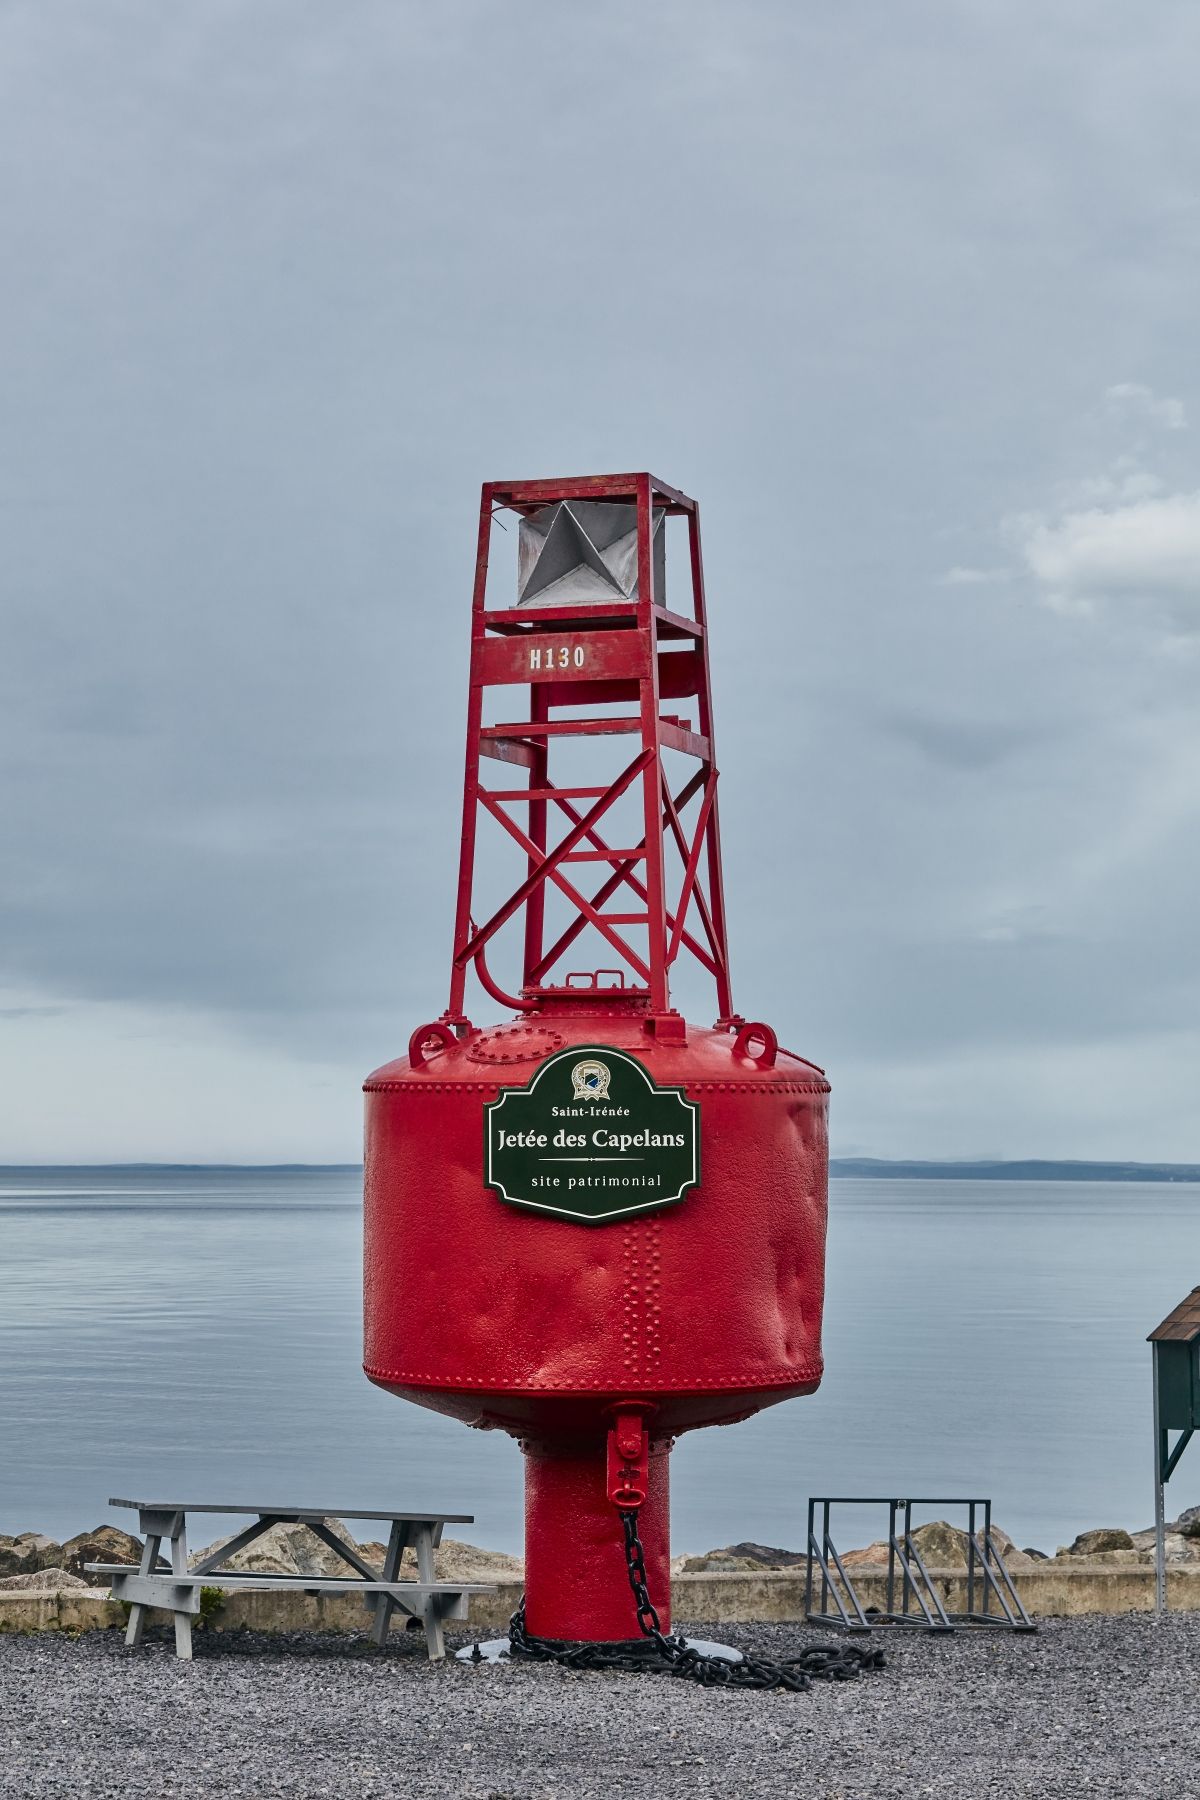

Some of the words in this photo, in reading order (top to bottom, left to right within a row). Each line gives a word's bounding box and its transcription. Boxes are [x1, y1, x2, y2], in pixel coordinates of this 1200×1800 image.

[530, 646, 584, 669] H130
[552, 1106, 630, 1117] Saint-Irénée
[498, 1130, 548, 1150] Jetée
[553, 1129, 587, 1147] des
[592, 1129, 685, 1151] Capelans
[531, 1176, 561, 1187] site
[568, 1175, 661, 1189] patrimonial
